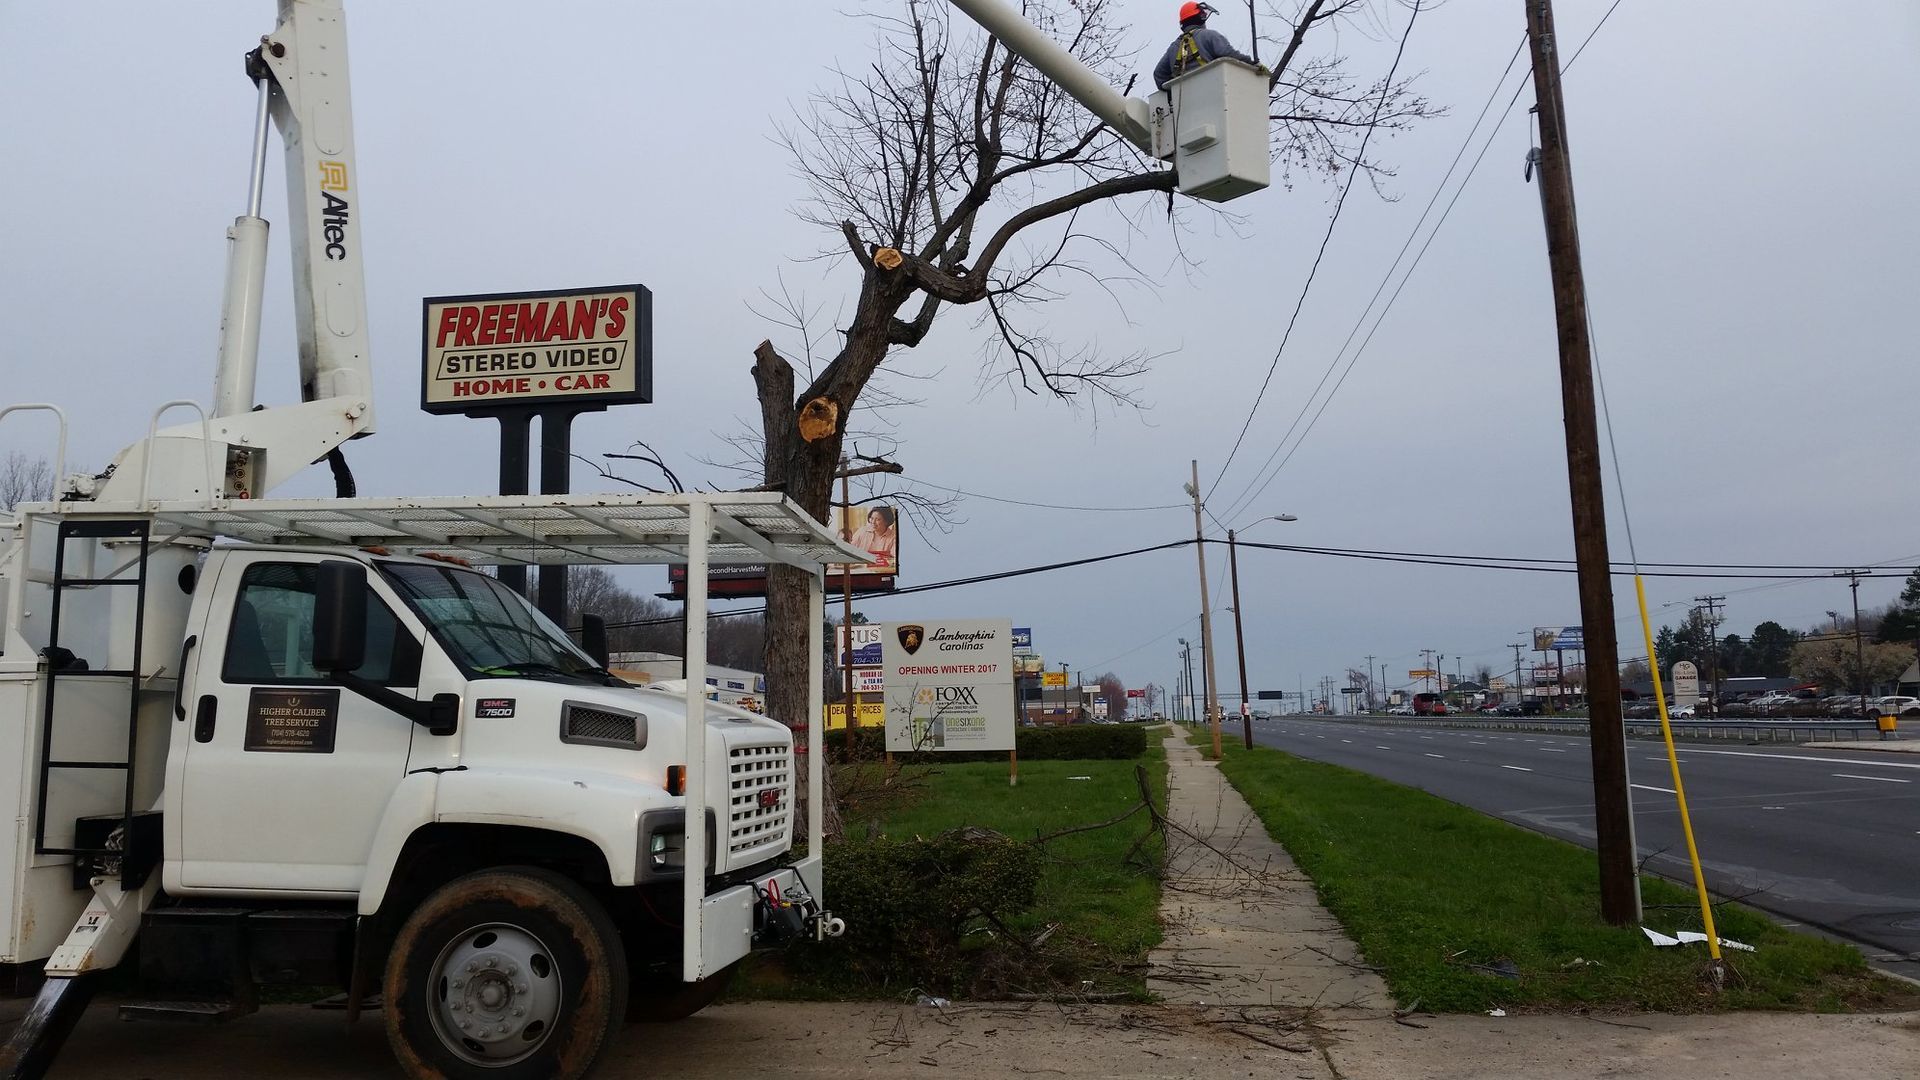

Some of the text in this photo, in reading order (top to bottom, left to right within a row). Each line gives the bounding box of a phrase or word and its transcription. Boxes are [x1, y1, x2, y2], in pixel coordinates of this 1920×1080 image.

[321, 190, 349, 260] Altec
[436, 297, 629, 348] FREEMAN'S
[446, 347, 618, 374] STEREO VIDEO
[453, 374, 611, 397] HOME CAR
[928, 627, 996, 643] Lamborghini
[939, 642, 984, 651] Carolinas
[898, 664, 998, 675] OPENING WINTER 2017
[935, 686, 979, 705] FOXX
[260, 707, 327, 717] HIGHER CALIBER
[832, 706, 857, 714] DEAR
[265, 718, 320, 727] TREE SERVICE
